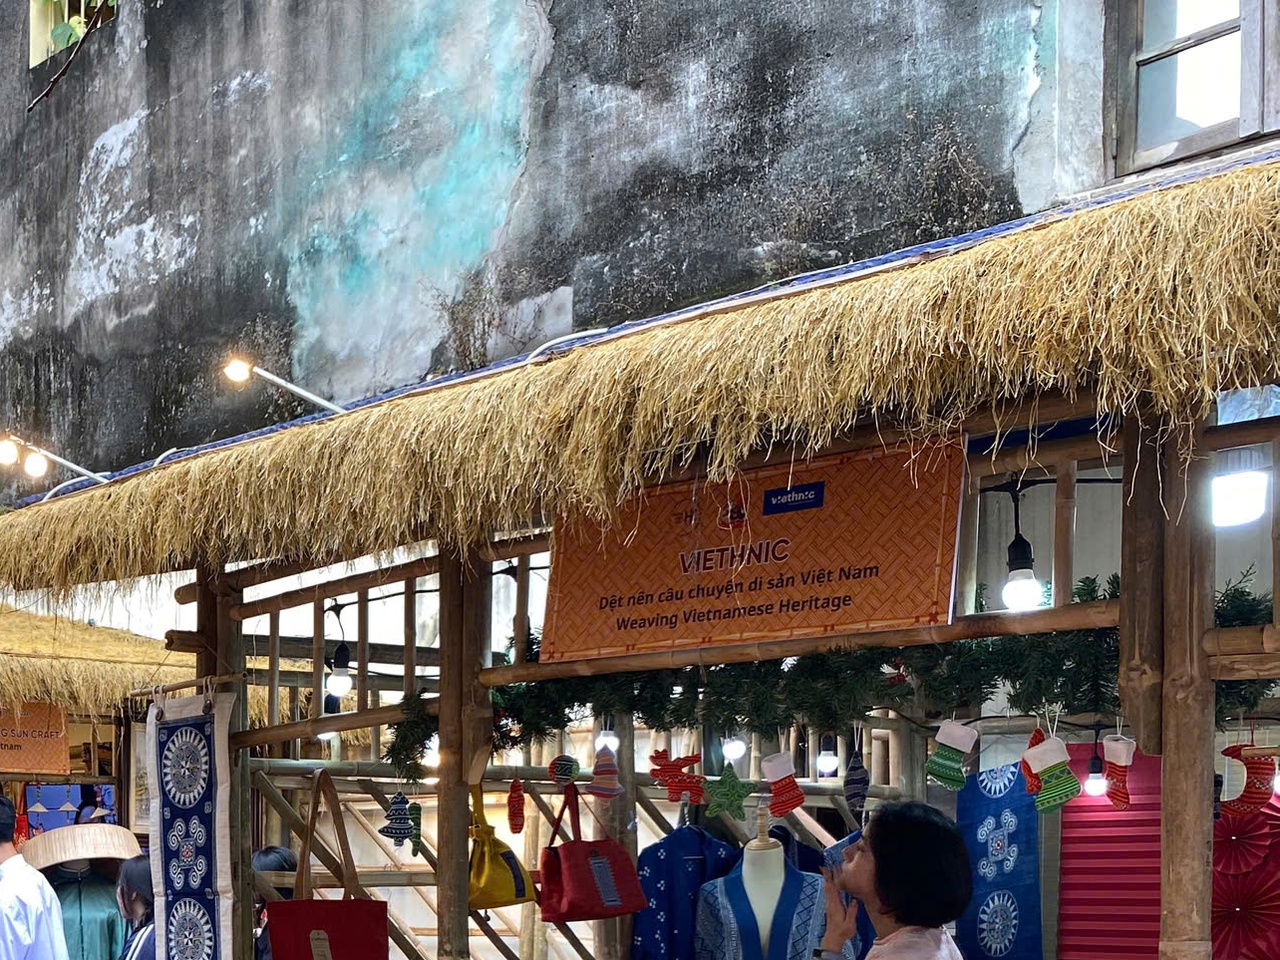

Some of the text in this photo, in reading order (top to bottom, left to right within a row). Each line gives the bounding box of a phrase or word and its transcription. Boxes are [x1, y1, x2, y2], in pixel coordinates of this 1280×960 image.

[679, 537, 791, 574] VIETHNIC
[599, 565, 880, 612] Dệt nên câu chuyện di sản Việt Nam
[616, 594, 852, 630] Weaving Vietnamese Heritage
[11, 728, 29, 739] SUN
[31, 730, 60, 739] CRAFT
